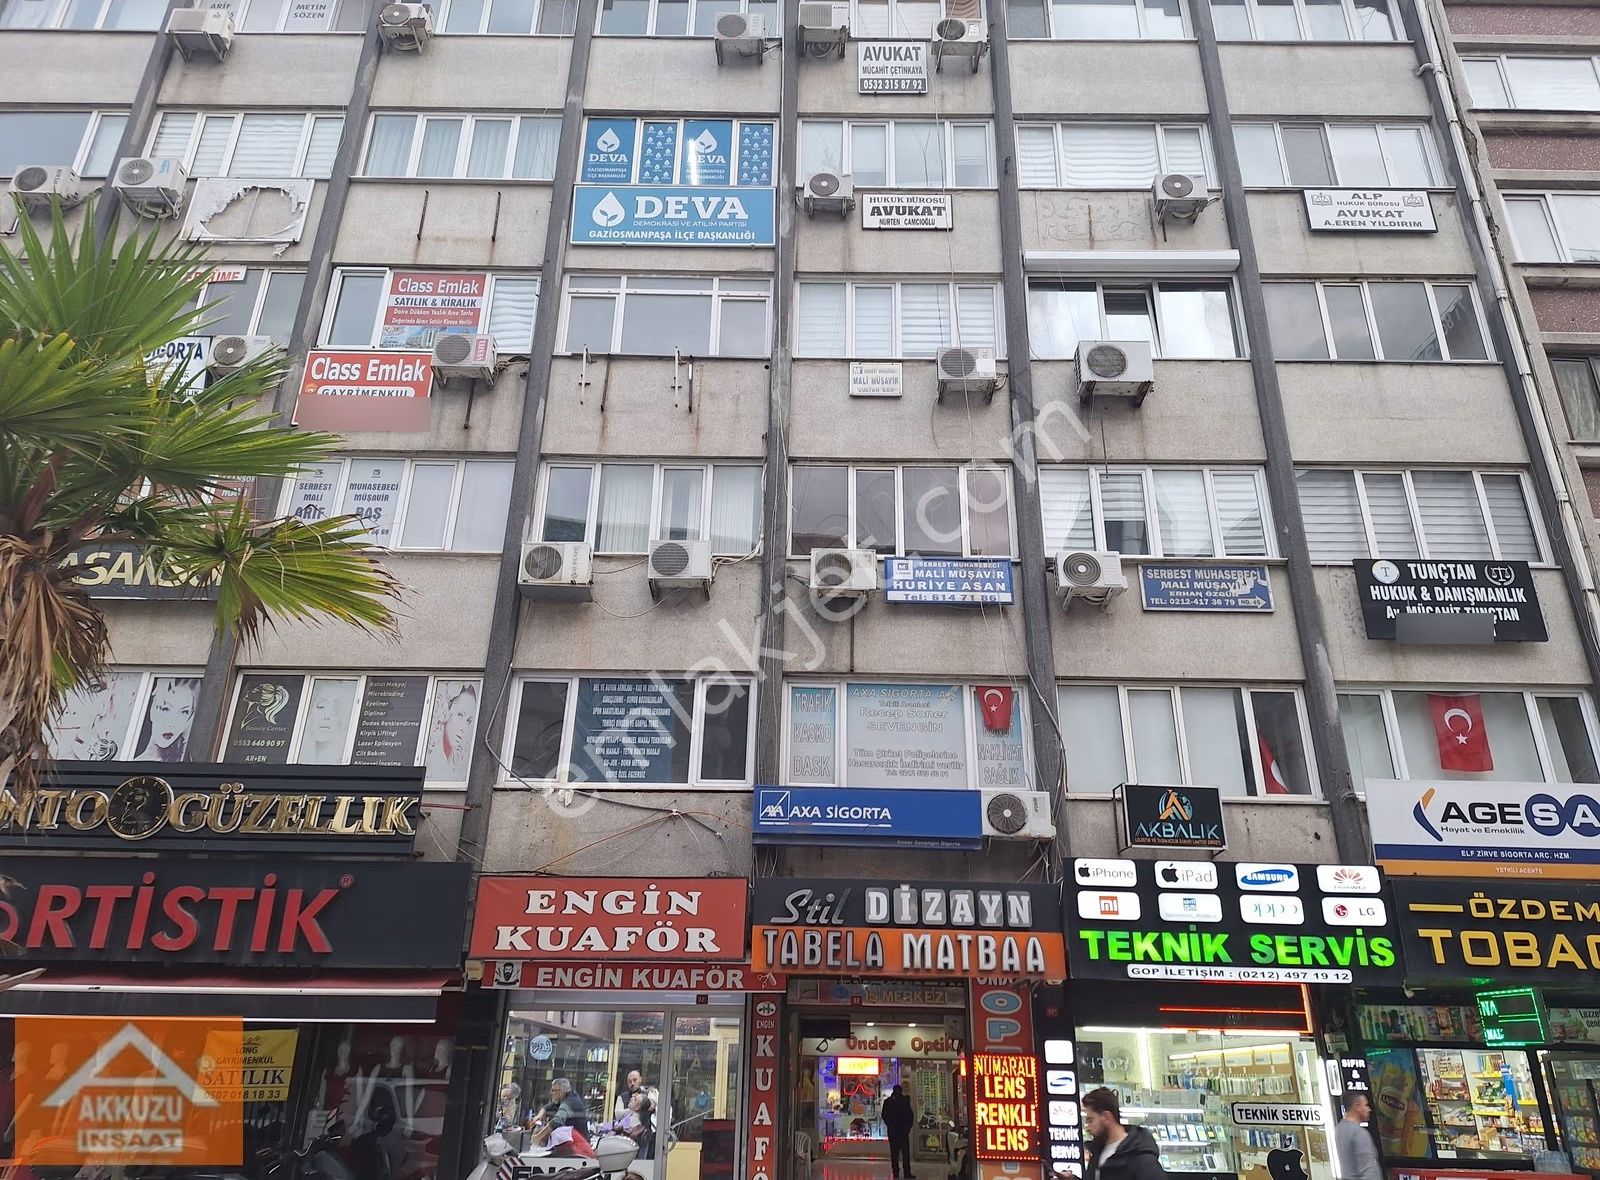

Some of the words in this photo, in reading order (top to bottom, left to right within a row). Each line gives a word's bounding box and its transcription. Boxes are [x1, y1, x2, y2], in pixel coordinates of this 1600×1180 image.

[863, 46, 922, 62] AVUKAT
[862, 64, 889, 75] MÜCAHİT
[890, 64, 923, 76] ÇETİNKAYA
[863, 80, 883, 90] 0532
[884, 80, 899, 90] 315
[900, 80, 910, 90] 87
[912, 80, 923, 90] 92
[588, 154, 628, 162] DEVA
[869, 196, 904, 204] HUKUK
[906, 196, 945, 204] BÜROSU
[634, 196, 749, 220] DEVA
[870, 206, 946, 216] AVUKAT
[1336, 210, 1404, 218] AVUKAT
[632, 219, 680, 228] DEMOKRASİ
[718, 220, 748, 228] PARTİSİ
[588, 230, 672, 240] GAZİOSMANPAŞA
[674, 230, 695, 240] İLÇE
[697, 230, 756, 241] BAŞKANLIĞI
[398, 278, 434, 293] Class
[437, 278, 480, 294] Emlak
[394, 297, 429, 306] SATILIK
[430, 298, 438, 306] &
[440, 296, 477, 308] KİRALIK
[311, 357, 362, 381] Class
[366, 358, 424, 382] Emlak
[853, 376, 869, 384] MALİ
[872, 376, 899, 386] MÜŞAVİR
[299, 482, 332, 490] SERBEST
[350, 482, 399, 492] MUHASEBECİ
[303, 494, 323, 502] MALİ
[354, 494, 390, 502] MÜŞAVİR
[356, 506, 382, 521] BAŞ
[915, 569, 944, 579] MALİ
[948, 569, 1005, 580] MÜŞAVİR
[1146, 568, 1192, 579] SERBEST
[1408, 563, 1477, 583] TUNÇTAN
[893, 580, 956, 590] HURİYE
[961, 582, 1006, 591] ASAN
[1161, 581, 1190, 590] MALİ
[1205, 590, 1240, 598] ÖZGÜR
[1370, 586, 1418, 600] HUKUK
[1420, 587, 1431, 600] &
[1434, 587, 1528, 606] DANIŞMANLIK
[1170, 598, 1208, 606] 0212-417
[852, 688, 876, 697] AXA
[880, 687, 932, 698] SİGORTA
[795, 690, 832, 712] TRAFİK
[860, 708, 903, 719] Recep
[907, 708, 948, 719] Soner
[867, 721, 944, 732] SEVENGİN
[794, 724, 831, 744] KASKO
[794, 756, 830, 776] DASK
[984, 763, 1020, 784] SAĞLIK
[760, 806, 784, 818] AXA
[789, 806, 821, 818] AXA
[826, 804, 892, 820] SİGORTA
[1135, 822, 1220, 840] AKBALIK
[1441, 826, 1469, 835] Hayat
[1477, 850, 1498, 858] ZİRVE
[1500, 850, 1532, 859] SİGORTA
[1091, 867, 1134, 880] iPhone
[1181, 869, 1213, 884] iPad
[1247, 871, 1288, 882] SAMSUNG
[525, 884, 702, 916] ENGİN
[770, 888, 851, 925] Stil
[866, 884, 1033, 928] DİZAYN
[1359, 907, 1376, 916] LG
[494, 920, 721, 953] KUAFÖR
[763, 930, 884, 968] TABELA
[903, 932, 1045, 973] MATBAA
[1079, 924, 1234, 965] TEKNİK
[1249, 928, 1396, 968] SERVİS
[537, 964, 622, 988] ENGİN
[632, 966, 745, 990] KUAFÖR
[1131, 967, 1160, 976] GOP
[1164, 966, 1225, 978] İLETİŞİM
[1237, 969, 1280, 980] (0212)
[1284, 970, 1308, 979] 497
[1314, 971, 1328, 980] 19
[1334, 971, 1350, 980] 12
[846, 1031, 896, 1051] Önder
[235, 1046, 258, 1054] LONG
[216, 1056, 275, 1064] GAYRİMENKUL
[1341, 1058, 1366, 1069] SIFIR
[976, 1056, 1036, 1078] NUMARALI
[202, 1070, 286, 1085] SATILIK
[1352, 1070, 1360, 1080] &
[984, 1077, 1026, 1100] LENS
[1347, 1081, 1369, 1091] 2.EL
[204, 1090, 228, 1100] 0507
[230, 1090, 250, 1099] 018
[252, 1090, 266, 1099] 18
[267, 1090, 281, 1099] 33
[977, 1102, 1037, 1128] RENKLİ
[1237, 1106, 1280, 1121] TEKNİK
[1282, 1108, 1321, 1122] SERVİS
[986, 1127, 1030, 1152] LENS
[1049, 1126, 1080, 1141] TEKNİK
[1050, 1144, 1081, 1160] SERVİS
